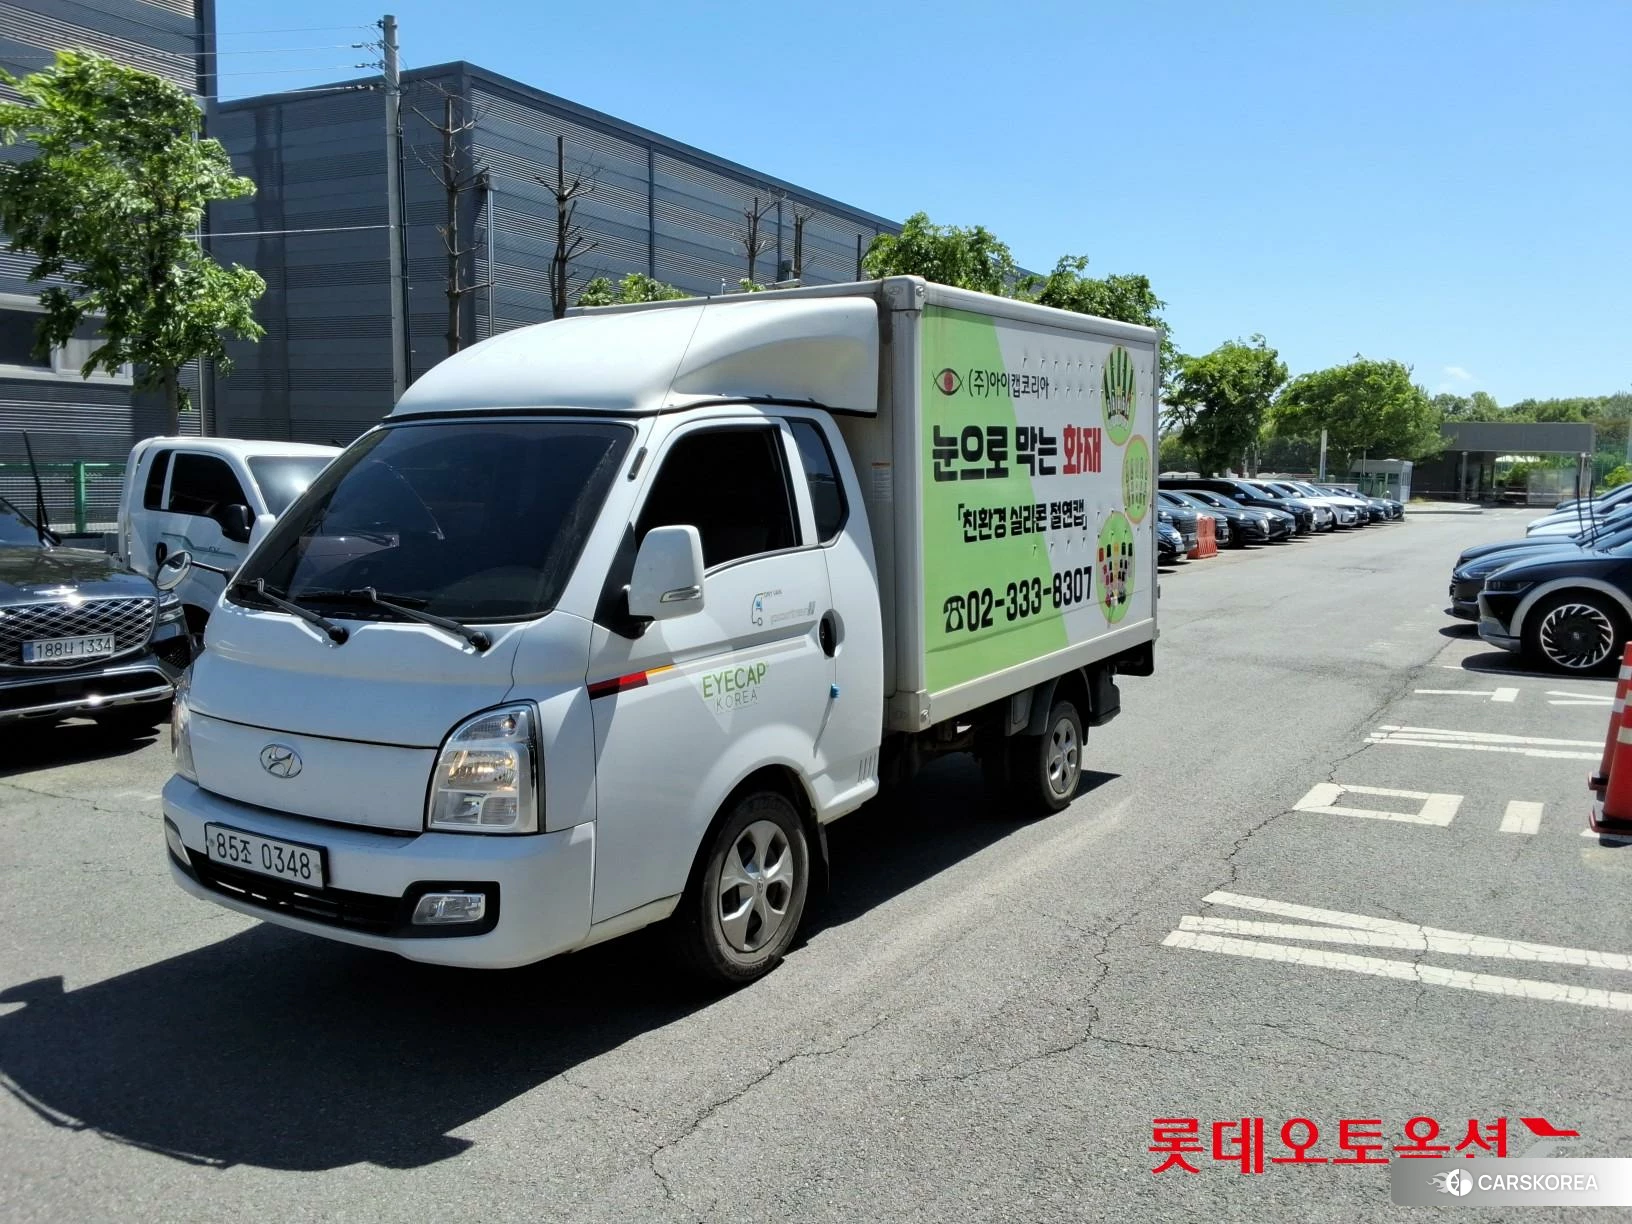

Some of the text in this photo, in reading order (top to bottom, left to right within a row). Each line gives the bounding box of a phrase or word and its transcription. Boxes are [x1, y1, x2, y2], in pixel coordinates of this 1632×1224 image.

[968, 368, 1050, 400] (주)아이캡코리아
[932, 424, 1102, 482] 눈으로 막는 화재
[1010, 504, 1048, 537] 실리콘
[967, 565, 1093, 633] 02-333-8307
[78, 637, 112, 655] 1334
[702, 662, 767, 699] EYECAP
[715, 687, 758, 713] KOREA
[216, 832, 312, 880] 85조 0348
